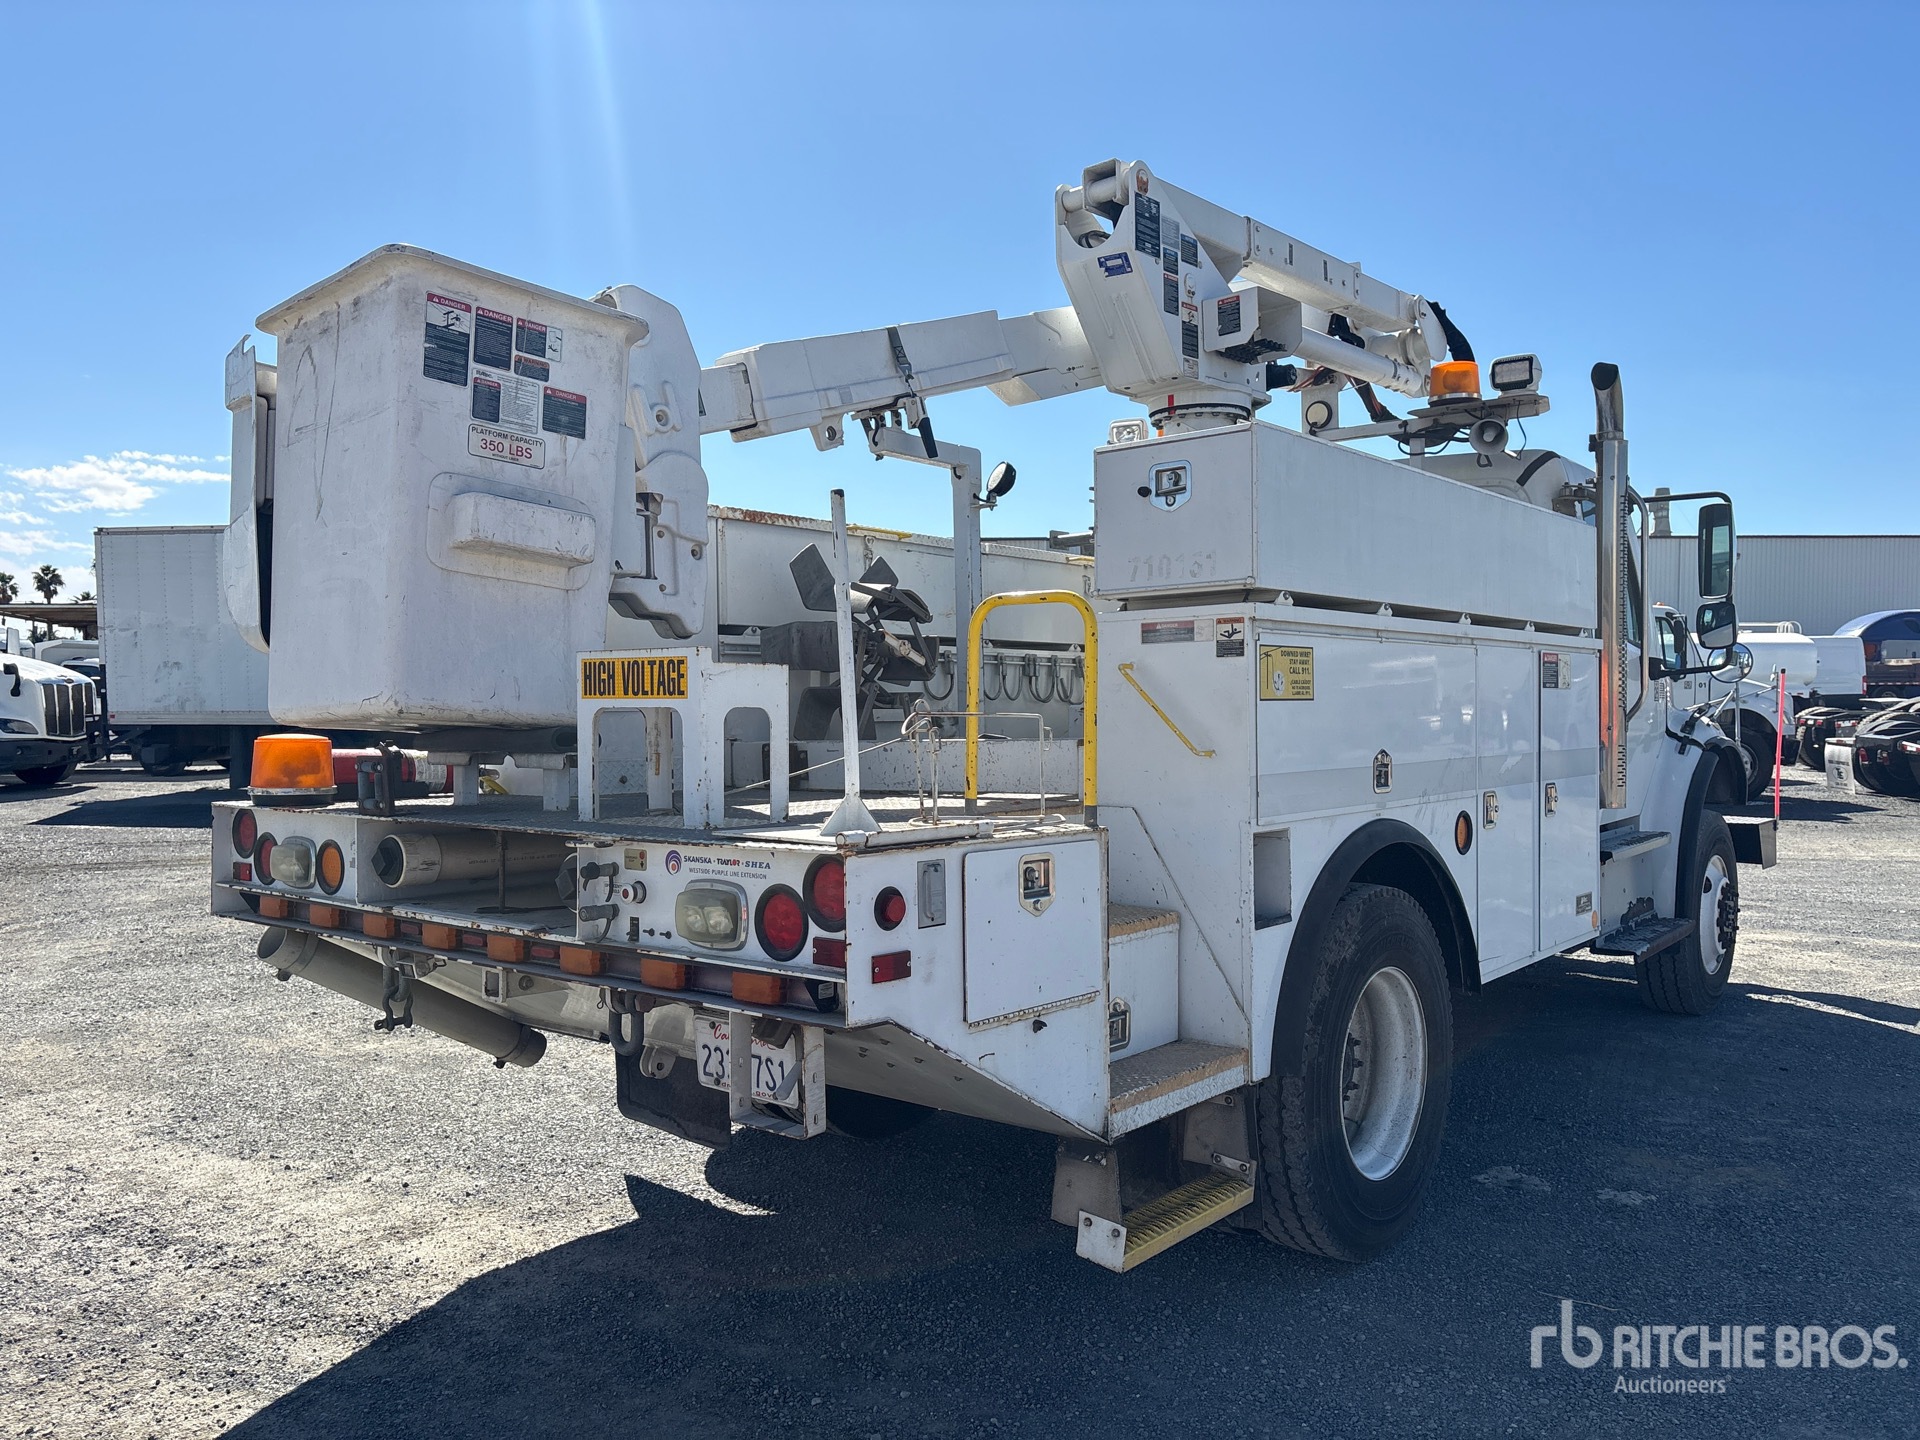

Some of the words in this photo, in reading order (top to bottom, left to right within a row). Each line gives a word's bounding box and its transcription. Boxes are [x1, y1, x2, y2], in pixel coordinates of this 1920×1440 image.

[440, 298, 466, 310] DANGER
[484, 309, 513, 323] DANGER
[525, 320, 546, 332] DANGER
[481, 379, 498, 387] DANGER
[555, 390, 577, 400] DANGER
[471, 426, 508, 440] PLATFORM
[510, 434, 543, 447] CAPACITY
[480, 438, 504, 453] 350
[509, 443, 532, 459] LBS
[1289, 666, 1300, 674] CALL
[583, 660, 615, 696] HIGH
[621, 659, 685, 696] VOLTAGE
[683, 855, 713, 864] SKANSKA
[716, 857, 740, 867] TRAYLOR
[745, 860, 771, 870] SHEA
[689, 867, 711, 875] WESTSIDE
[740, 871, 767, 880] EXTENSION
